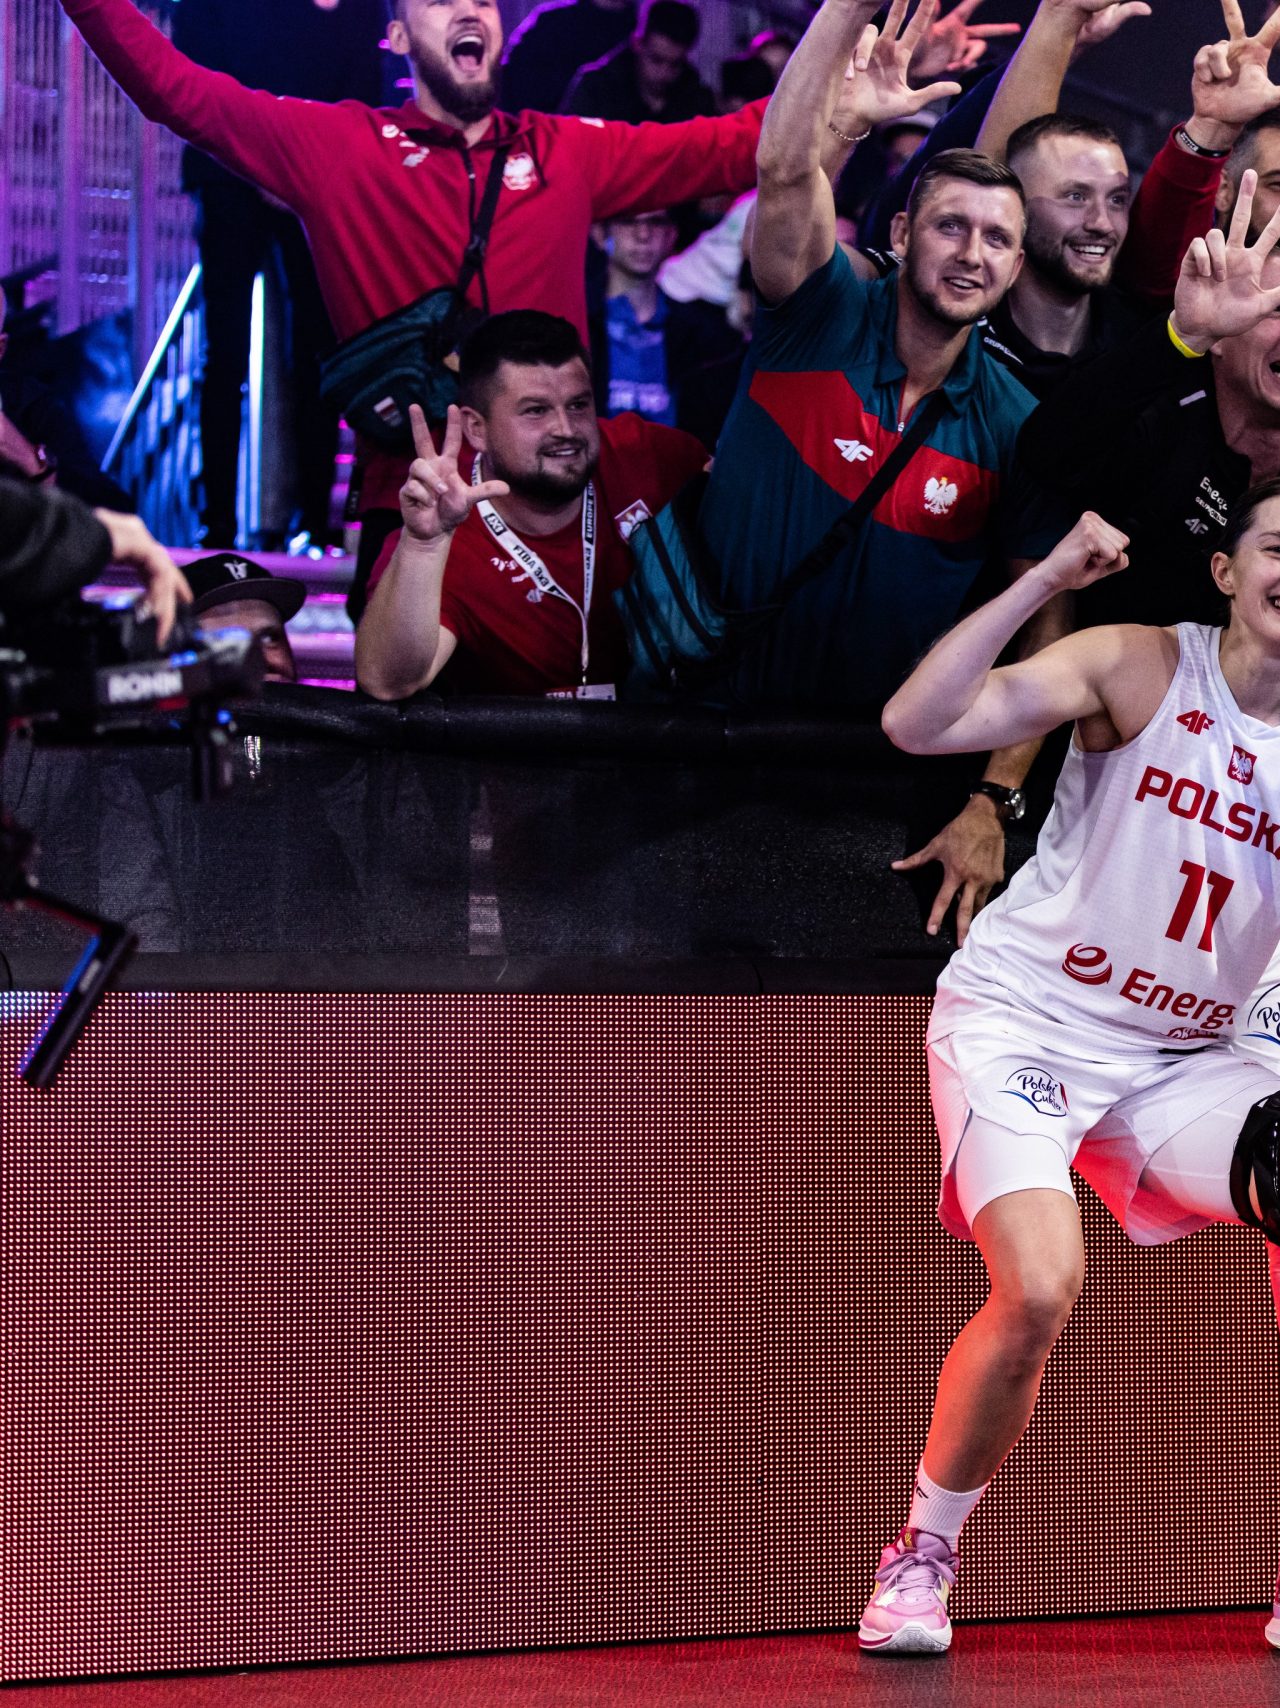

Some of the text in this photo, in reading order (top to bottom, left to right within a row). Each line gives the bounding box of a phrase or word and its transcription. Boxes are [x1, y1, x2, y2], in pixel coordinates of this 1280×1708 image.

[833, 438, 874, 463] 4F
[513, 545, 537, 570] FIBA
[1176, 709, 1216, 736] 4F
[1165, 859, 1235, 953] 11
[1119, 968, 1238, 1030] Energ
[1017, 1074, 1059, 1093] Polski
